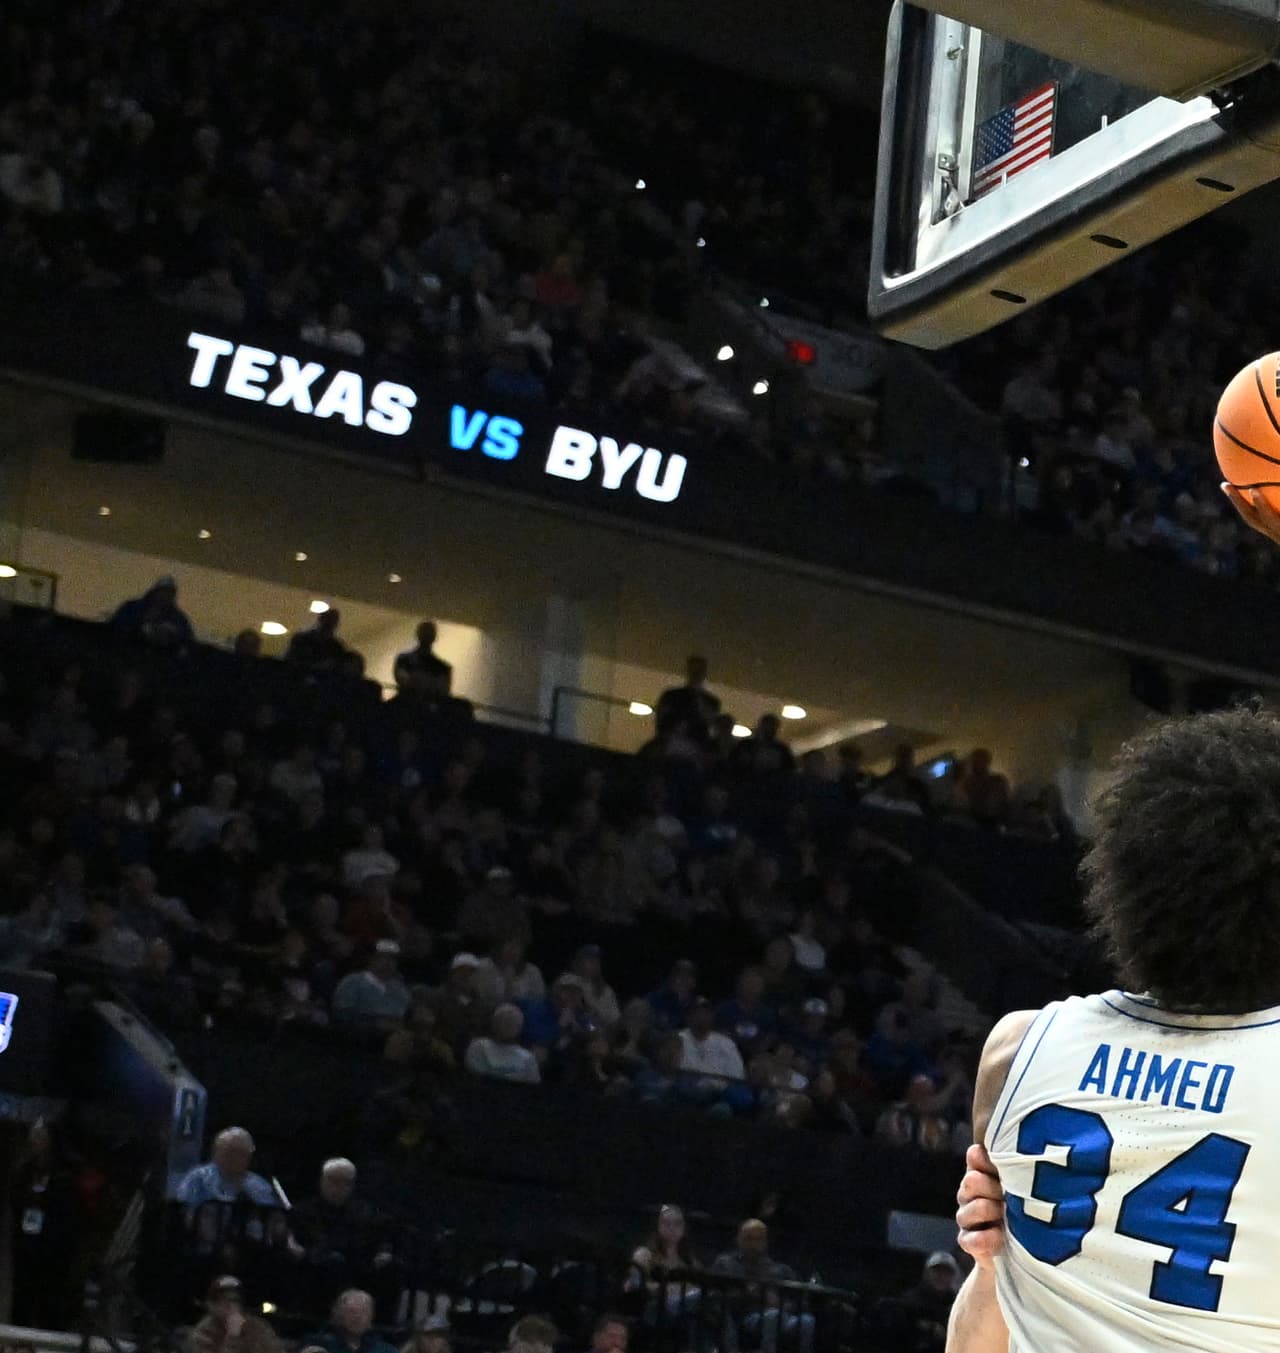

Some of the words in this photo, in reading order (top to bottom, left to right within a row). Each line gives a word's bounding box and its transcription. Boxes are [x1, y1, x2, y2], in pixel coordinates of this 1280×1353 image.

[187, 332, 418, 436] TEXAS
[450, 404, 524, 460] VS
[545, 425, 688, 503] BYU
[1078, 1043, 1236, 1114] AHMED
[1004, 1102, 1252, 1313] 34
